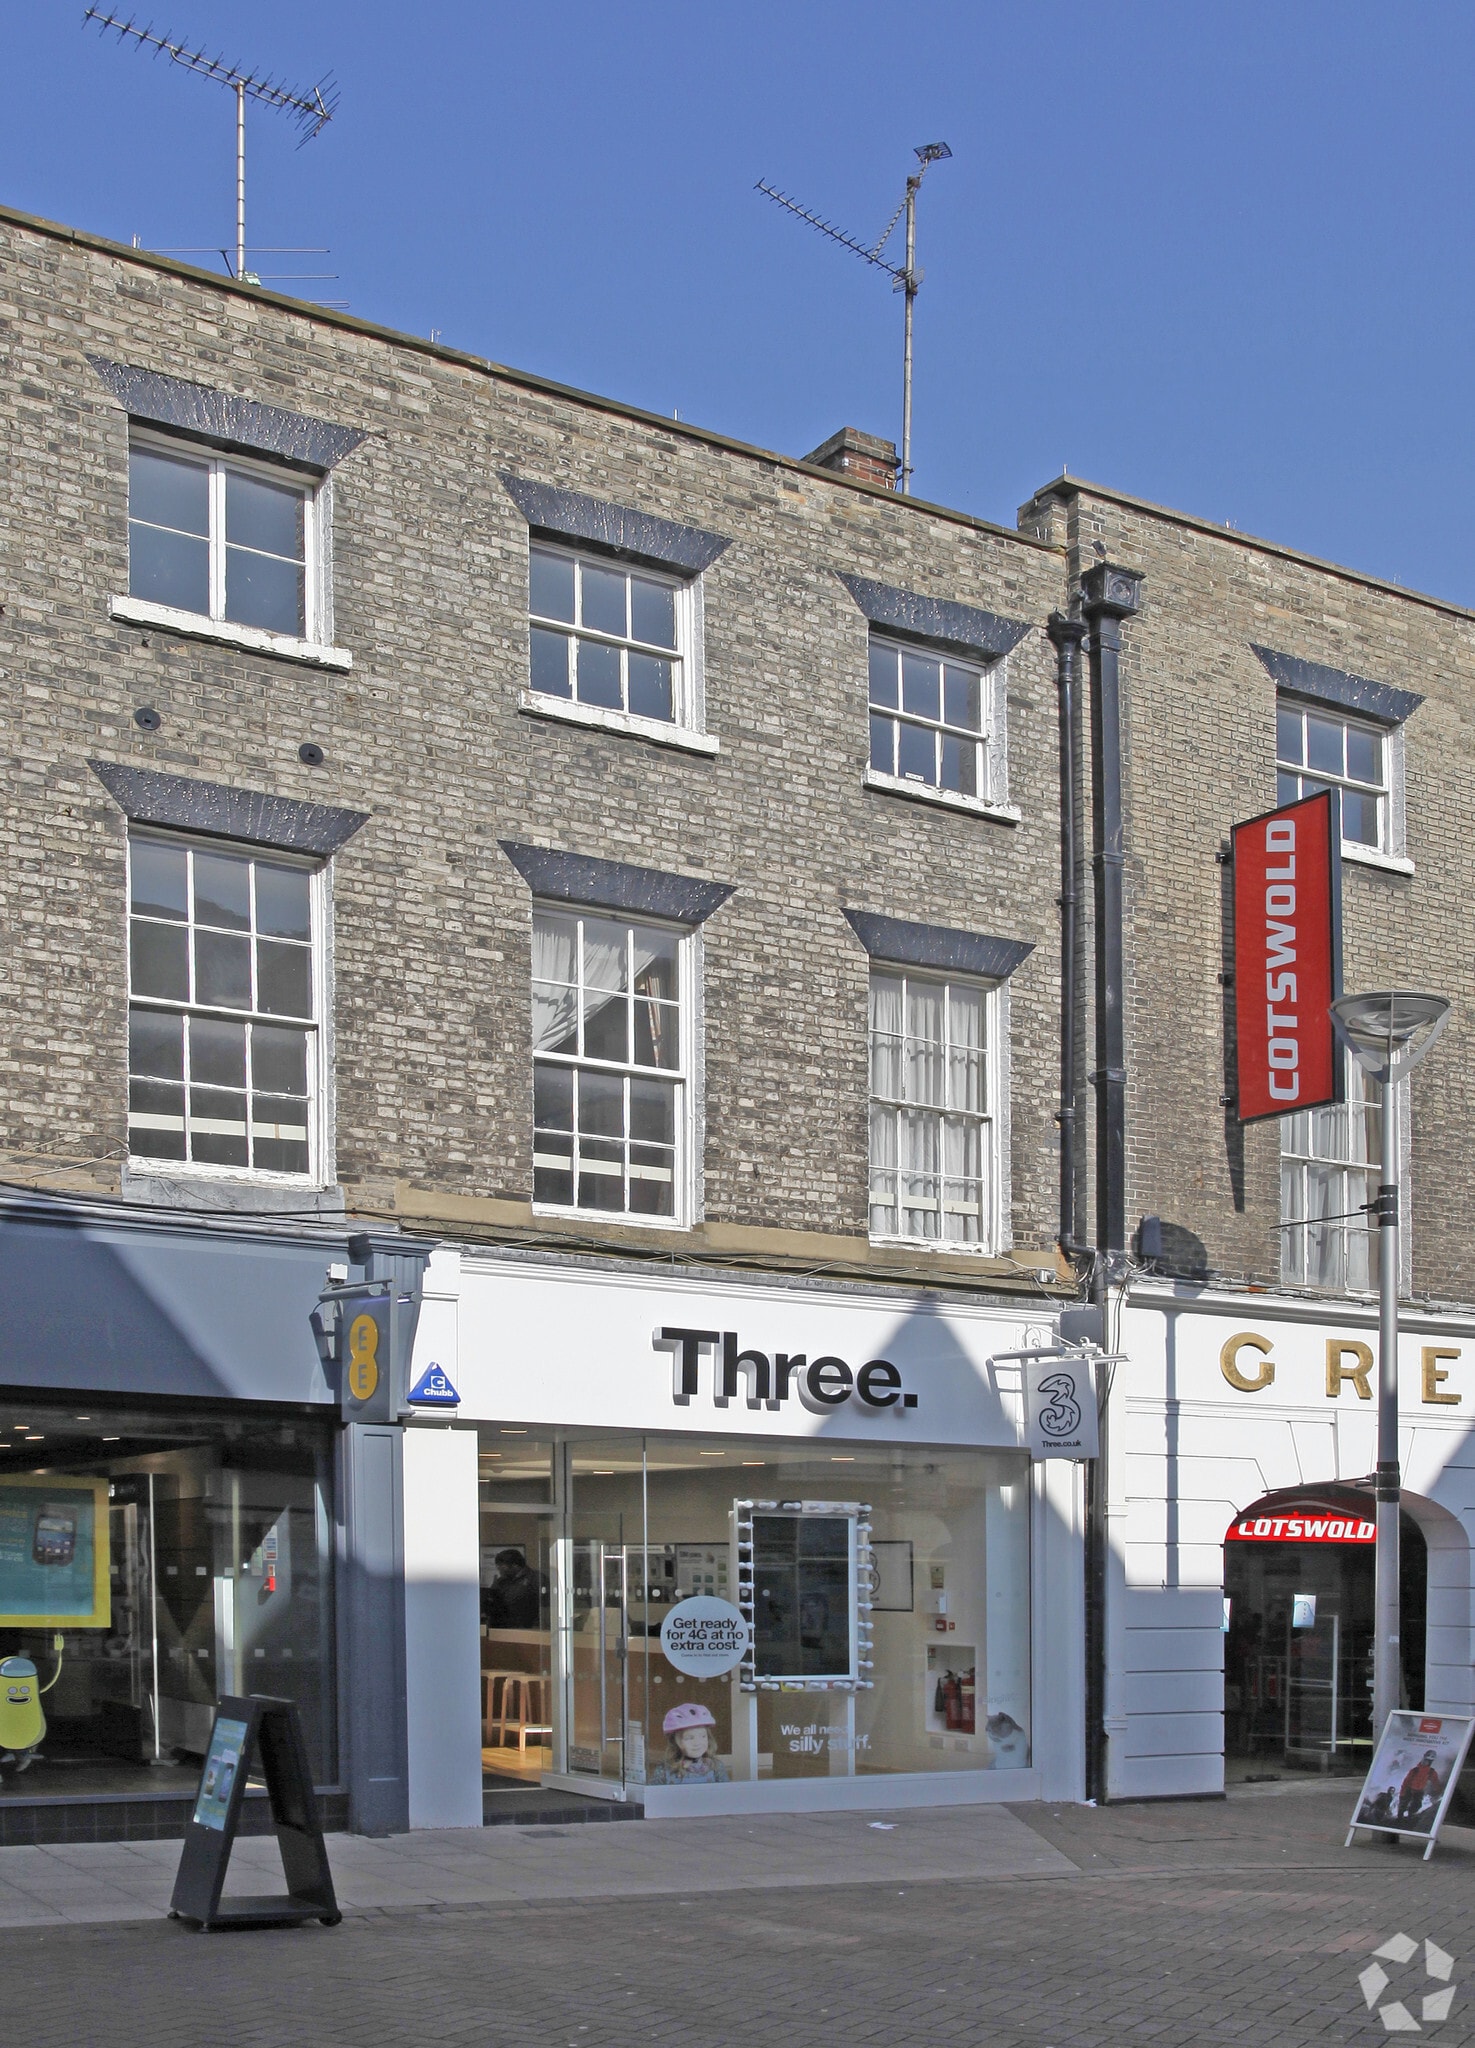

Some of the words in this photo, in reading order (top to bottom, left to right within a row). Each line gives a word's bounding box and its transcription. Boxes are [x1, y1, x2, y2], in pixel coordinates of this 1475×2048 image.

[1265, 819, 1300, 1101] COTSWOLD
[655, 1326, 919, 1411] Three.
[423, 1387, 454, 1398] Chubb
[1041, 1440, 1082, 1448] Three.co.uk
[1238, 1518, 1376, 1539] COTSWOLD
[673, 1617, 698, 1629] Get
[700, 1618, 738, 1630] ready
[666, 1629, 686, 1640] for
[688, 1629, 708, 1640] 4G
[711, 1630, 723, 1640] at
[727, 1631, 744, 1640] no
[670, 1641, 705, 1650] extra
[707, 1640, 740, 1650] cost.
[780, 1724, 801, 1735] We
[803, 1723, 817, 1735] all
[789, 1735, 824, 1754] silly
